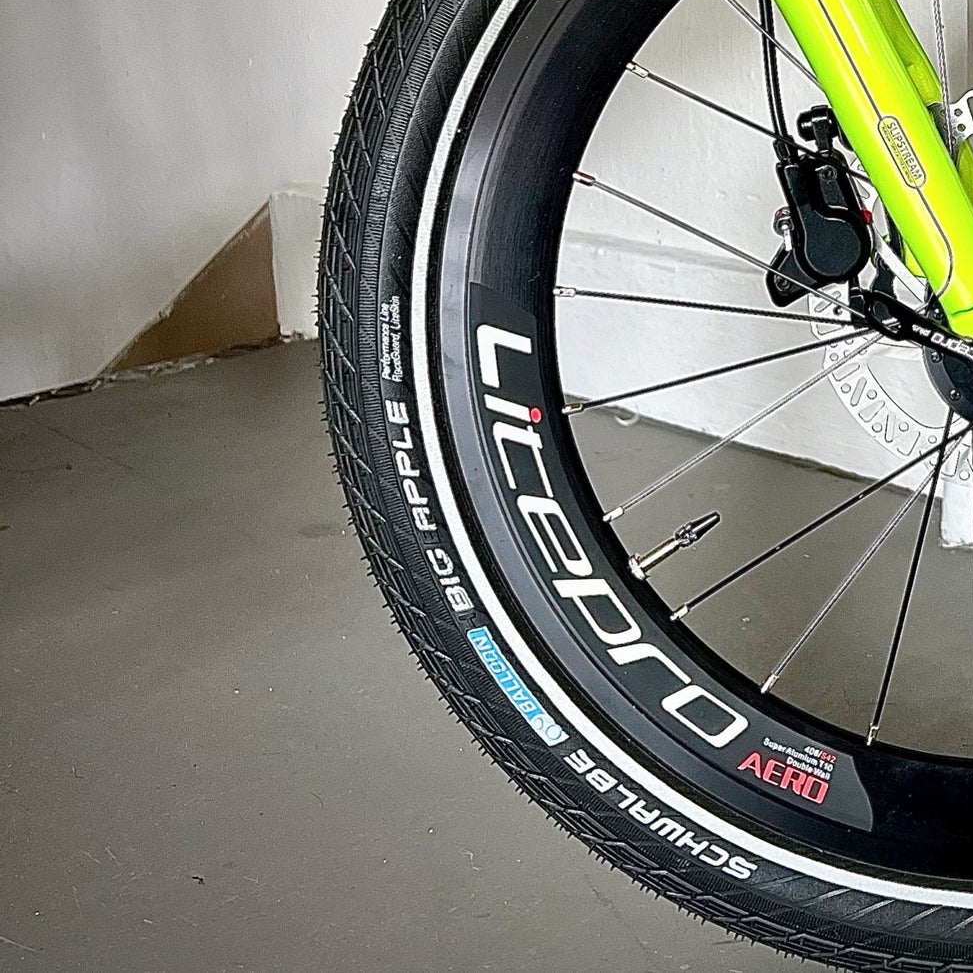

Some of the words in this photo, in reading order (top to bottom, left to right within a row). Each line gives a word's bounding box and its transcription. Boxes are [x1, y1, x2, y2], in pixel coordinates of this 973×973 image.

[886, 121, 922, 181] SLIPSTREAM
[384, 399, 438, 531] APPLE
[476, 324, 749, 749] Litepro
[426, 546, 473, 615] BIG
[472, 635, 534, 715] BALLOON
[737, 752, 829, 804] AERO
[763, 737, 785, 753] Super
[819, 759, 834, 772] T10
[786, 756, 813, 774] Double
[812, 767, 831, 781] Wall
[563, 748, 759, 880] SCHWALBE
